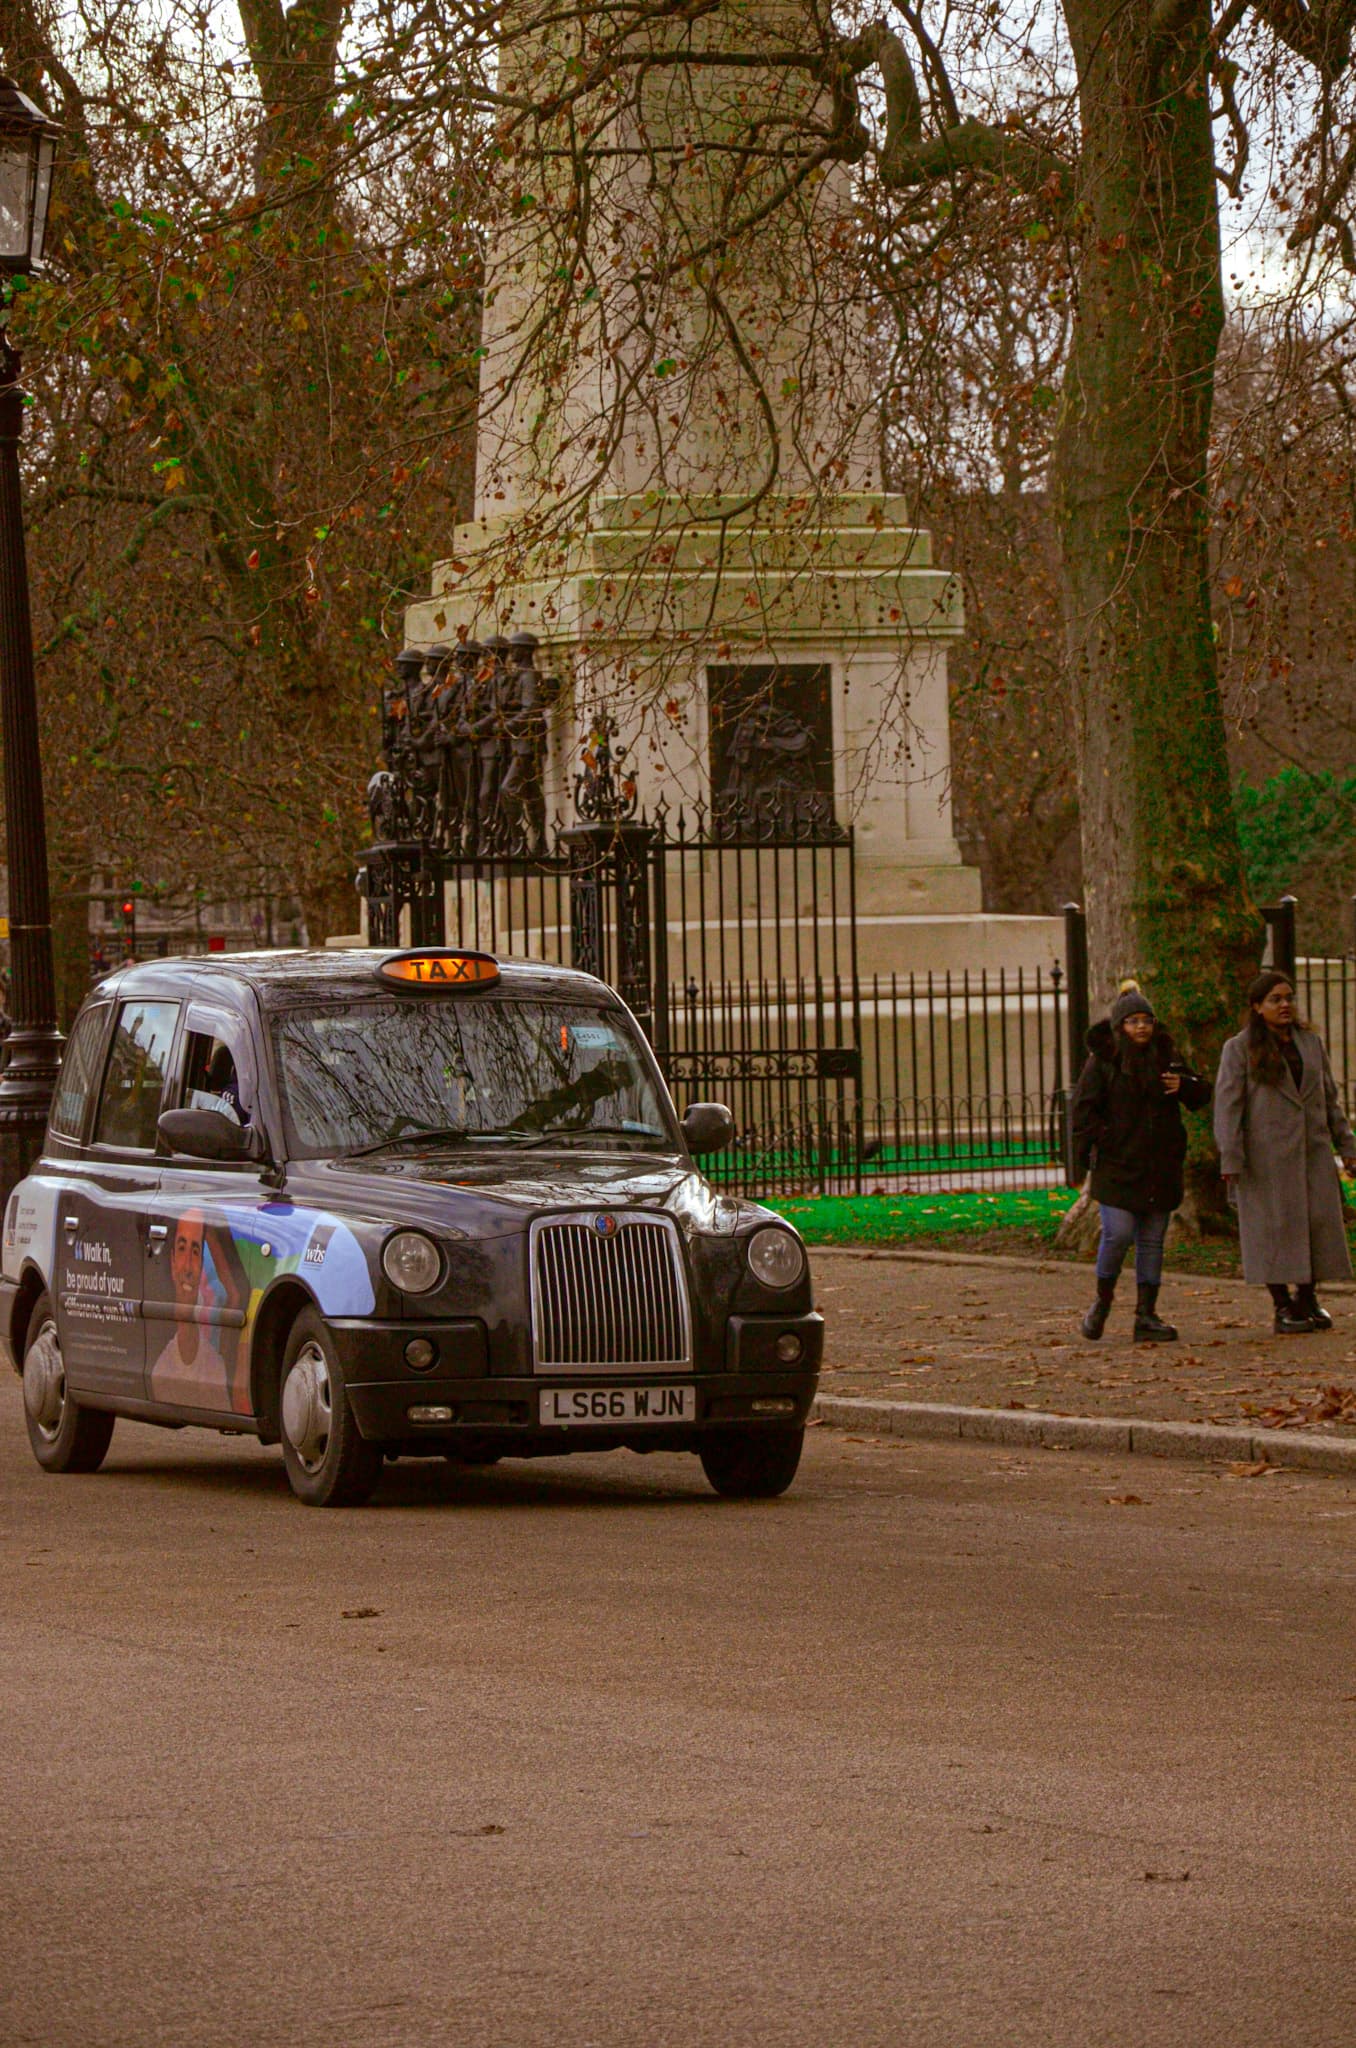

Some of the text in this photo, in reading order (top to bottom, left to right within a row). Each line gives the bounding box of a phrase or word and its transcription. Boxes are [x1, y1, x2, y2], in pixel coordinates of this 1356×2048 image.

[410, 960, 481, 980] TAXI
[306, 1243, 325, 1262] wbs
[66, 1268, 125, 1298] be proud of your
[554, 1390, 684, 1418] LS66 WJN
